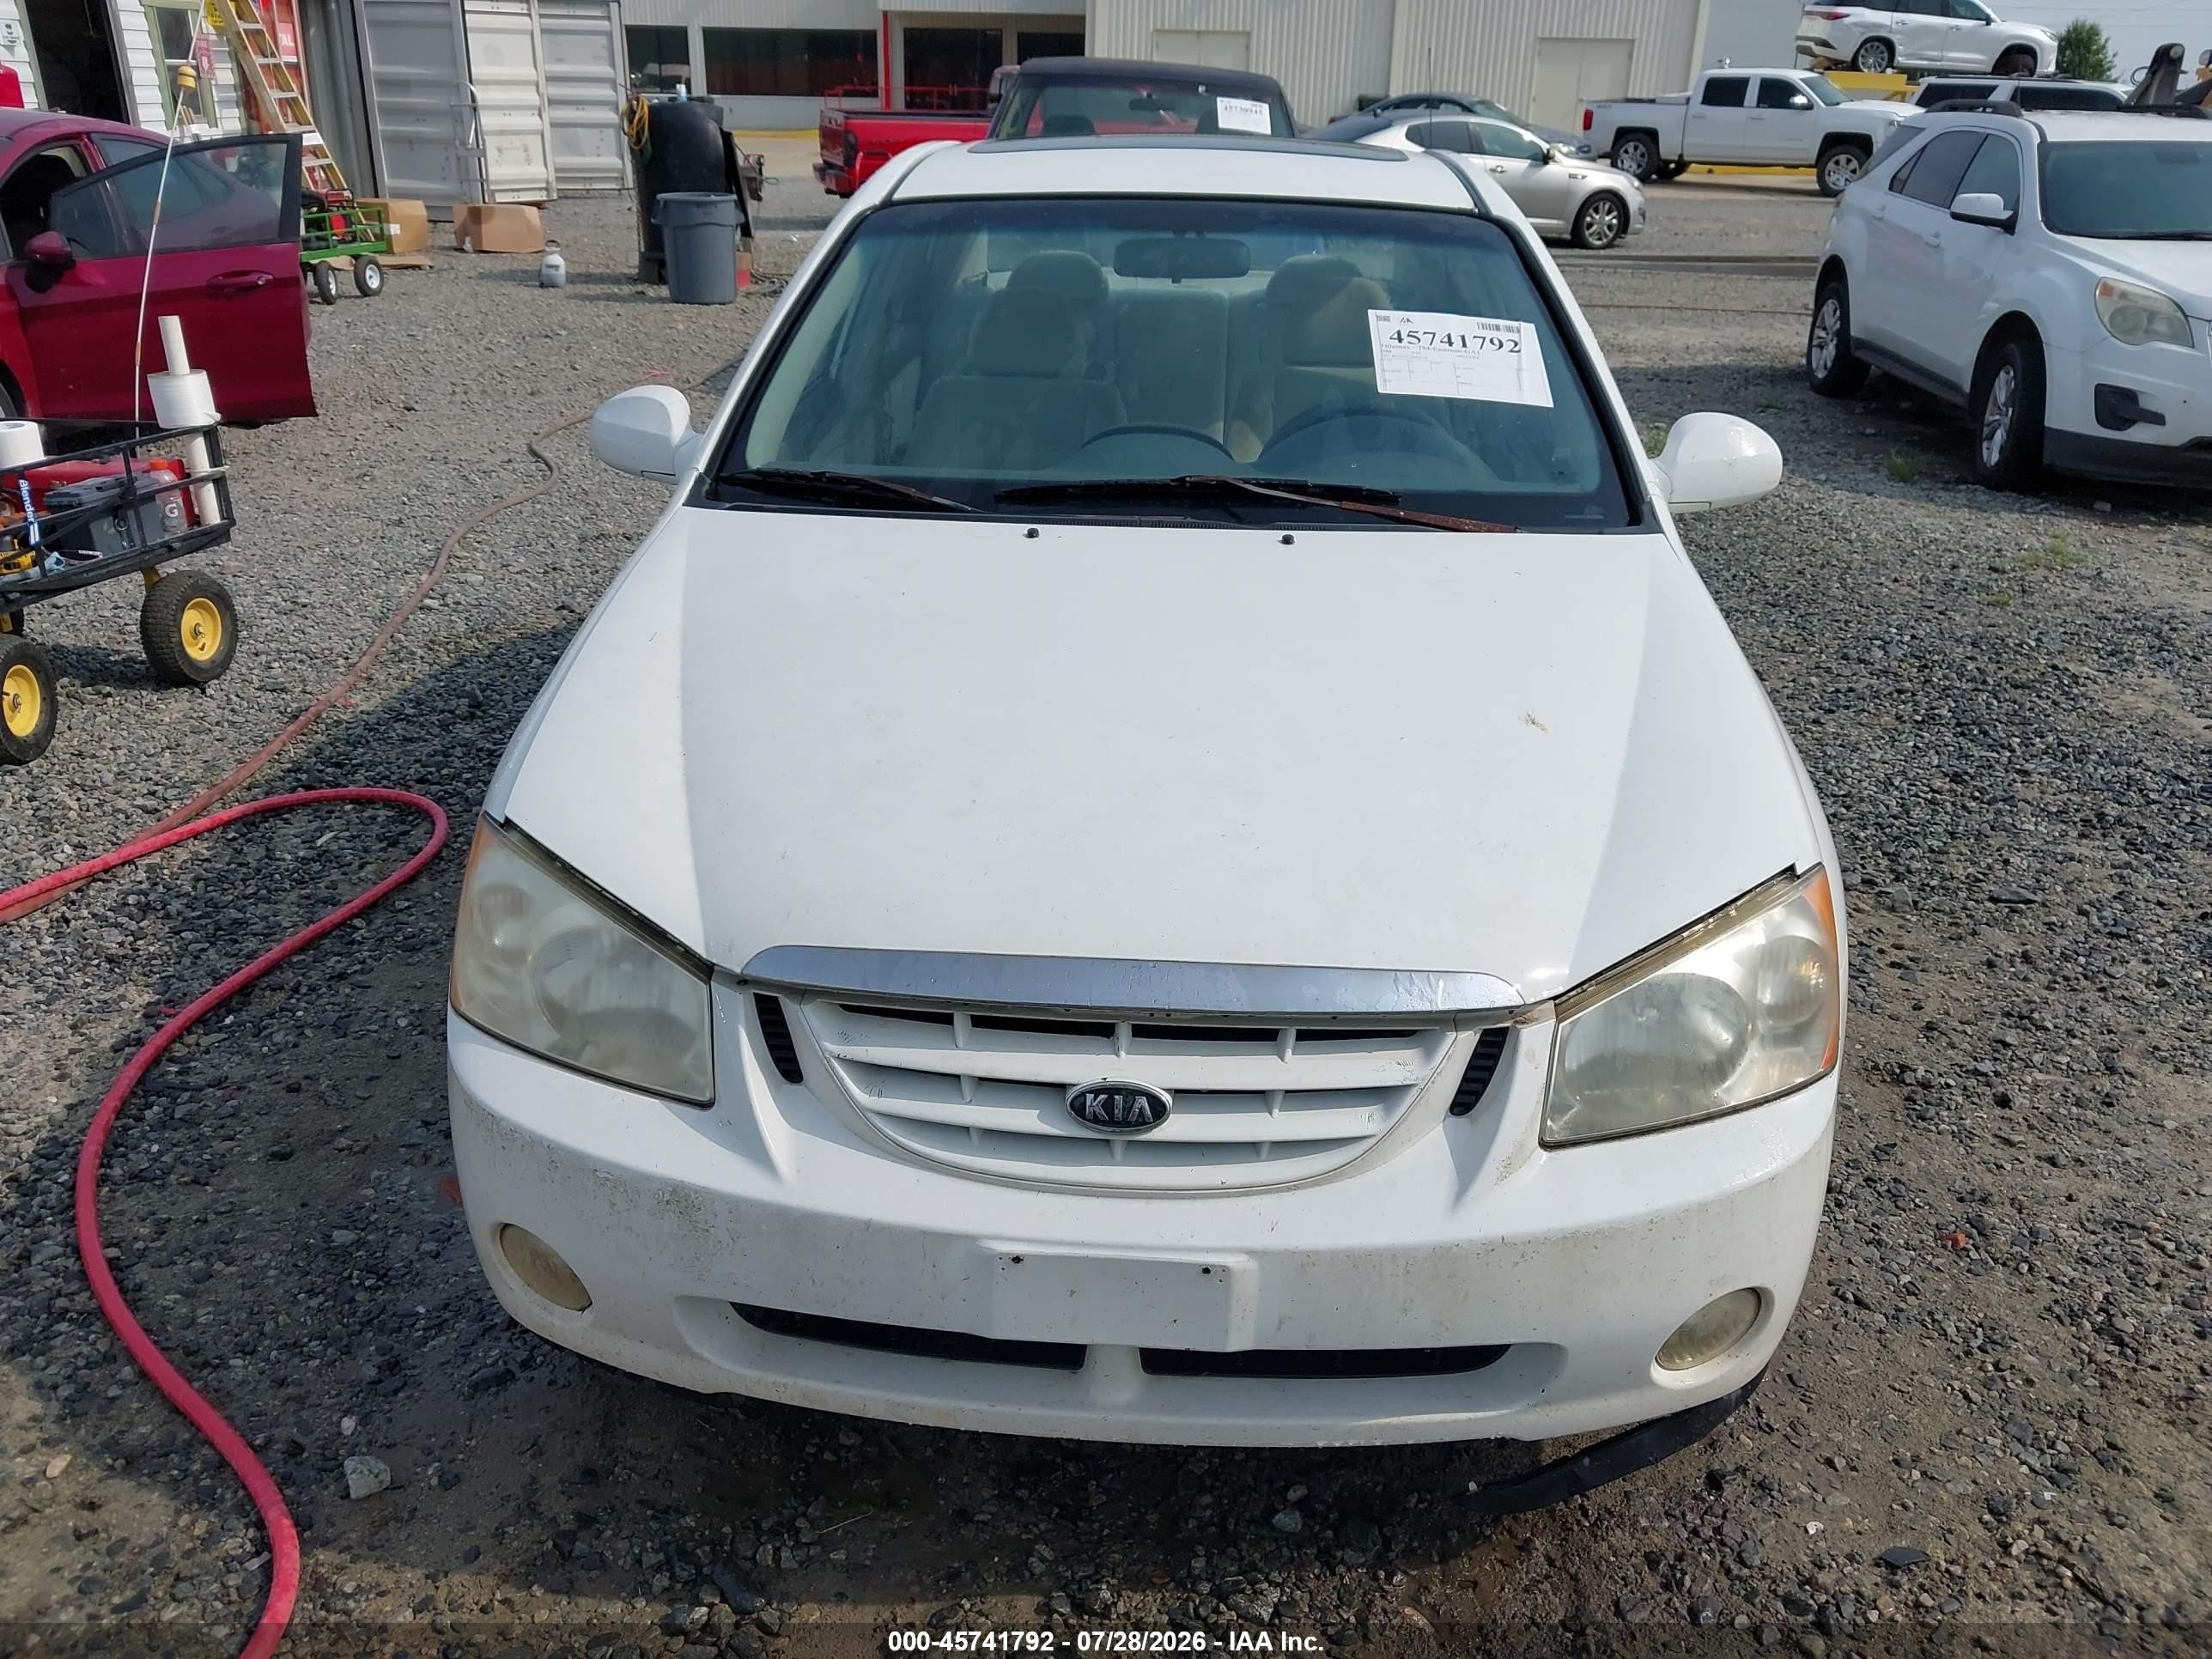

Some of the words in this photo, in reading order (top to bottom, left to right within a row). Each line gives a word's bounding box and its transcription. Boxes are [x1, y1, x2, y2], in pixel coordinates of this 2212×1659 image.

[1389, 329, 1522, 354] 45741792
[19, 479, 35, 523] Blender
[164, 503, 179, 518] G
[1085, 1093, 1154, 1123] KIA
